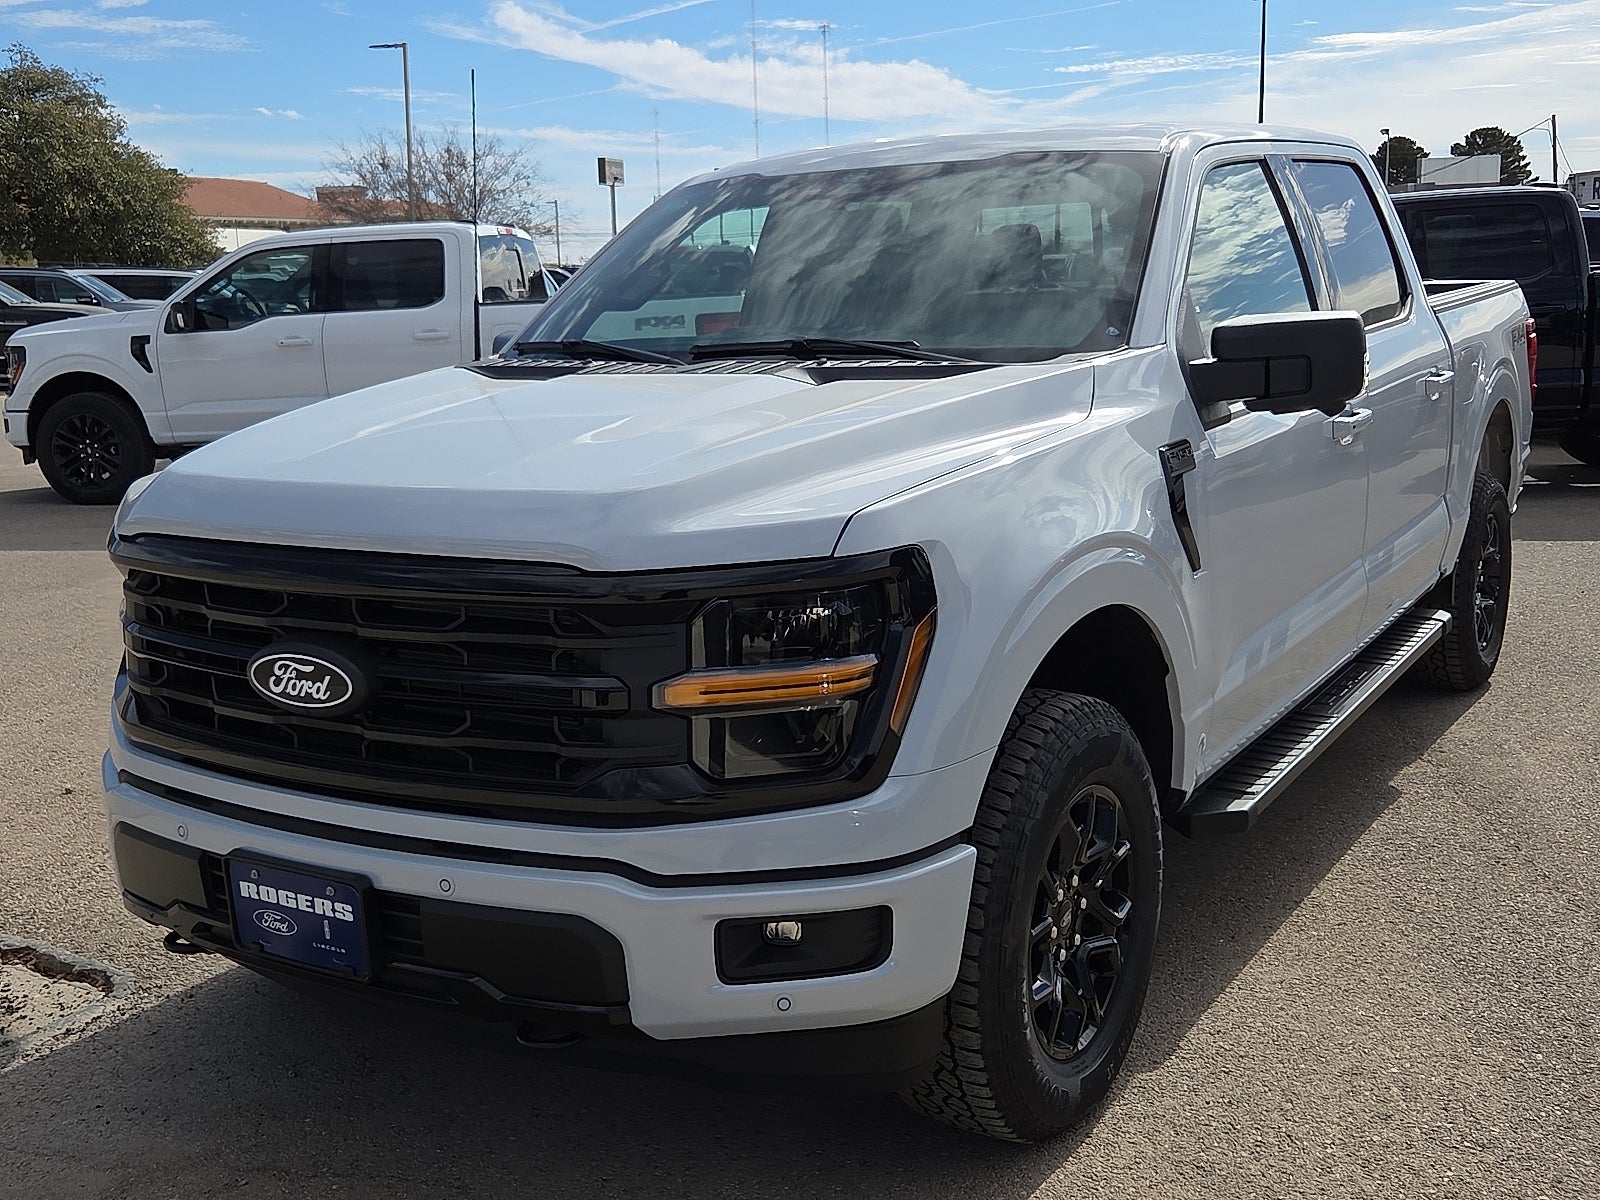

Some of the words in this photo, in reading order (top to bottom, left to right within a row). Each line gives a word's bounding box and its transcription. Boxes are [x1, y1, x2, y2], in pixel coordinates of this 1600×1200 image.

[269, 660, 331, 700] Ford
[239, 880, 354, 922] ROGERS
[262, 912, 289, 933] Ford
[312, 942, 346, 954] LINCOLN
